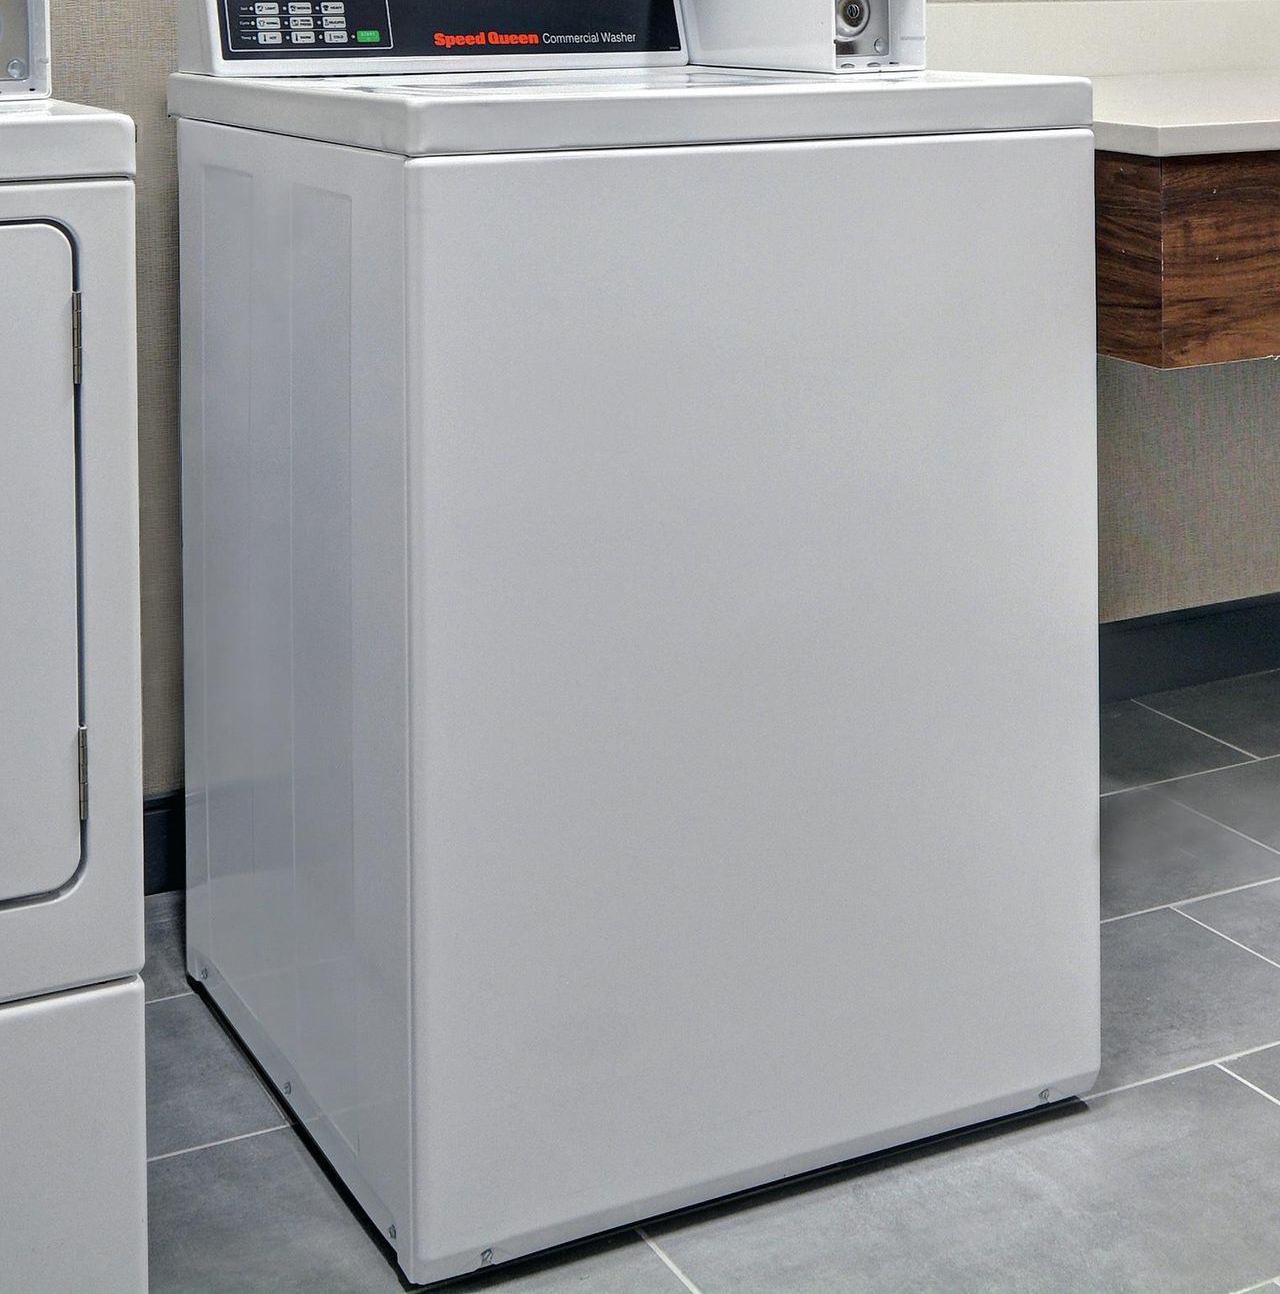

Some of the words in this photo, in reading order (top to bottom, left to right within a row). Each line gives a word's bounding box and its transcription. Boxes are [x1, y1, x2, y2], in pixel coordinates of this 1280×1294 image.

[433, 32, 486, 48] Speed
[488, 31, 539, 45] Queen
[542, 32, 600, 44] Commercial
[601, 32, 636, 43] Washer
